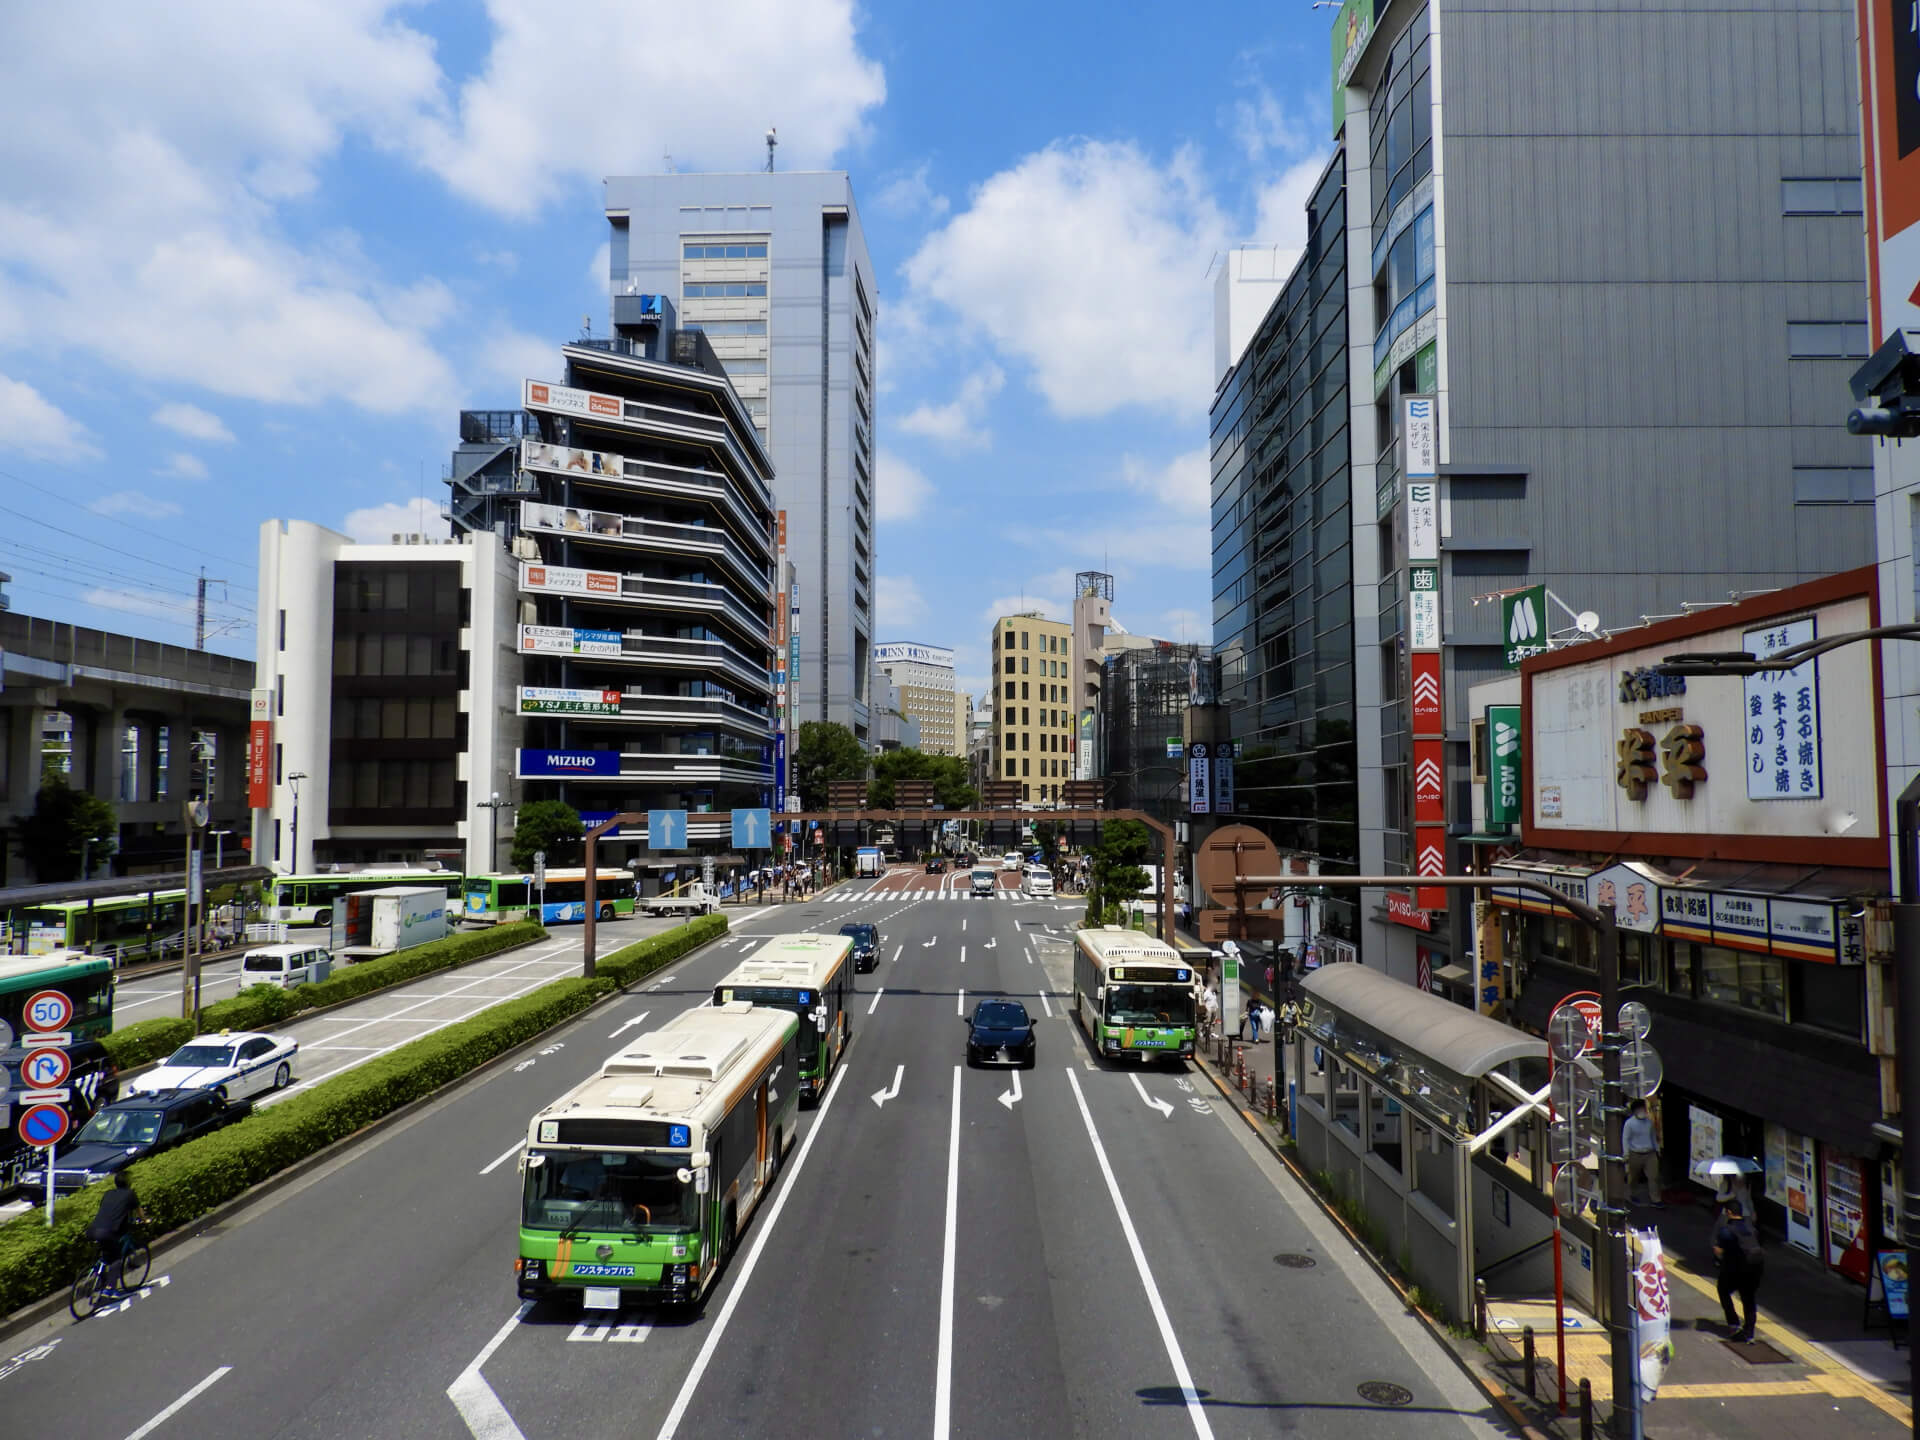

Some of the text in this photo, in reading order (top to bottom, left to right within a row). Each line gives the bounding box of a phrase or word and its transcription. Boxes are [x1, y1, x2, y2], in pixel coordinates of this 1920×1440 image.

[1337, 14, 1369, 91] JURAKU
[1411, 422, 1419, 449] ビザビ
[1421, 422, 1431, 466] 栄光の個別
[1411, 507, 1421, 547] ゼミナール
[1423, 507, 1432, 527] 栄光
[1413, 569, 1433, 588] 歯
[1750, 694, 1764, 774] 釜めし
[1772, 691, 1790, 792] 牛すき焼
[1797, 687, 1814, 792] 玉子焼き
[547, 755, 596, 766] MIZUHO
[1500, 765, 1517, 808] MOS
[1389, 899, 1411, 916] DAISO
[1666, 895, 1707, 917] 食処・銘酒
[35, 1002, 61, 1021] 50
[574, 1265, 635, 1276] ノンステップバス
